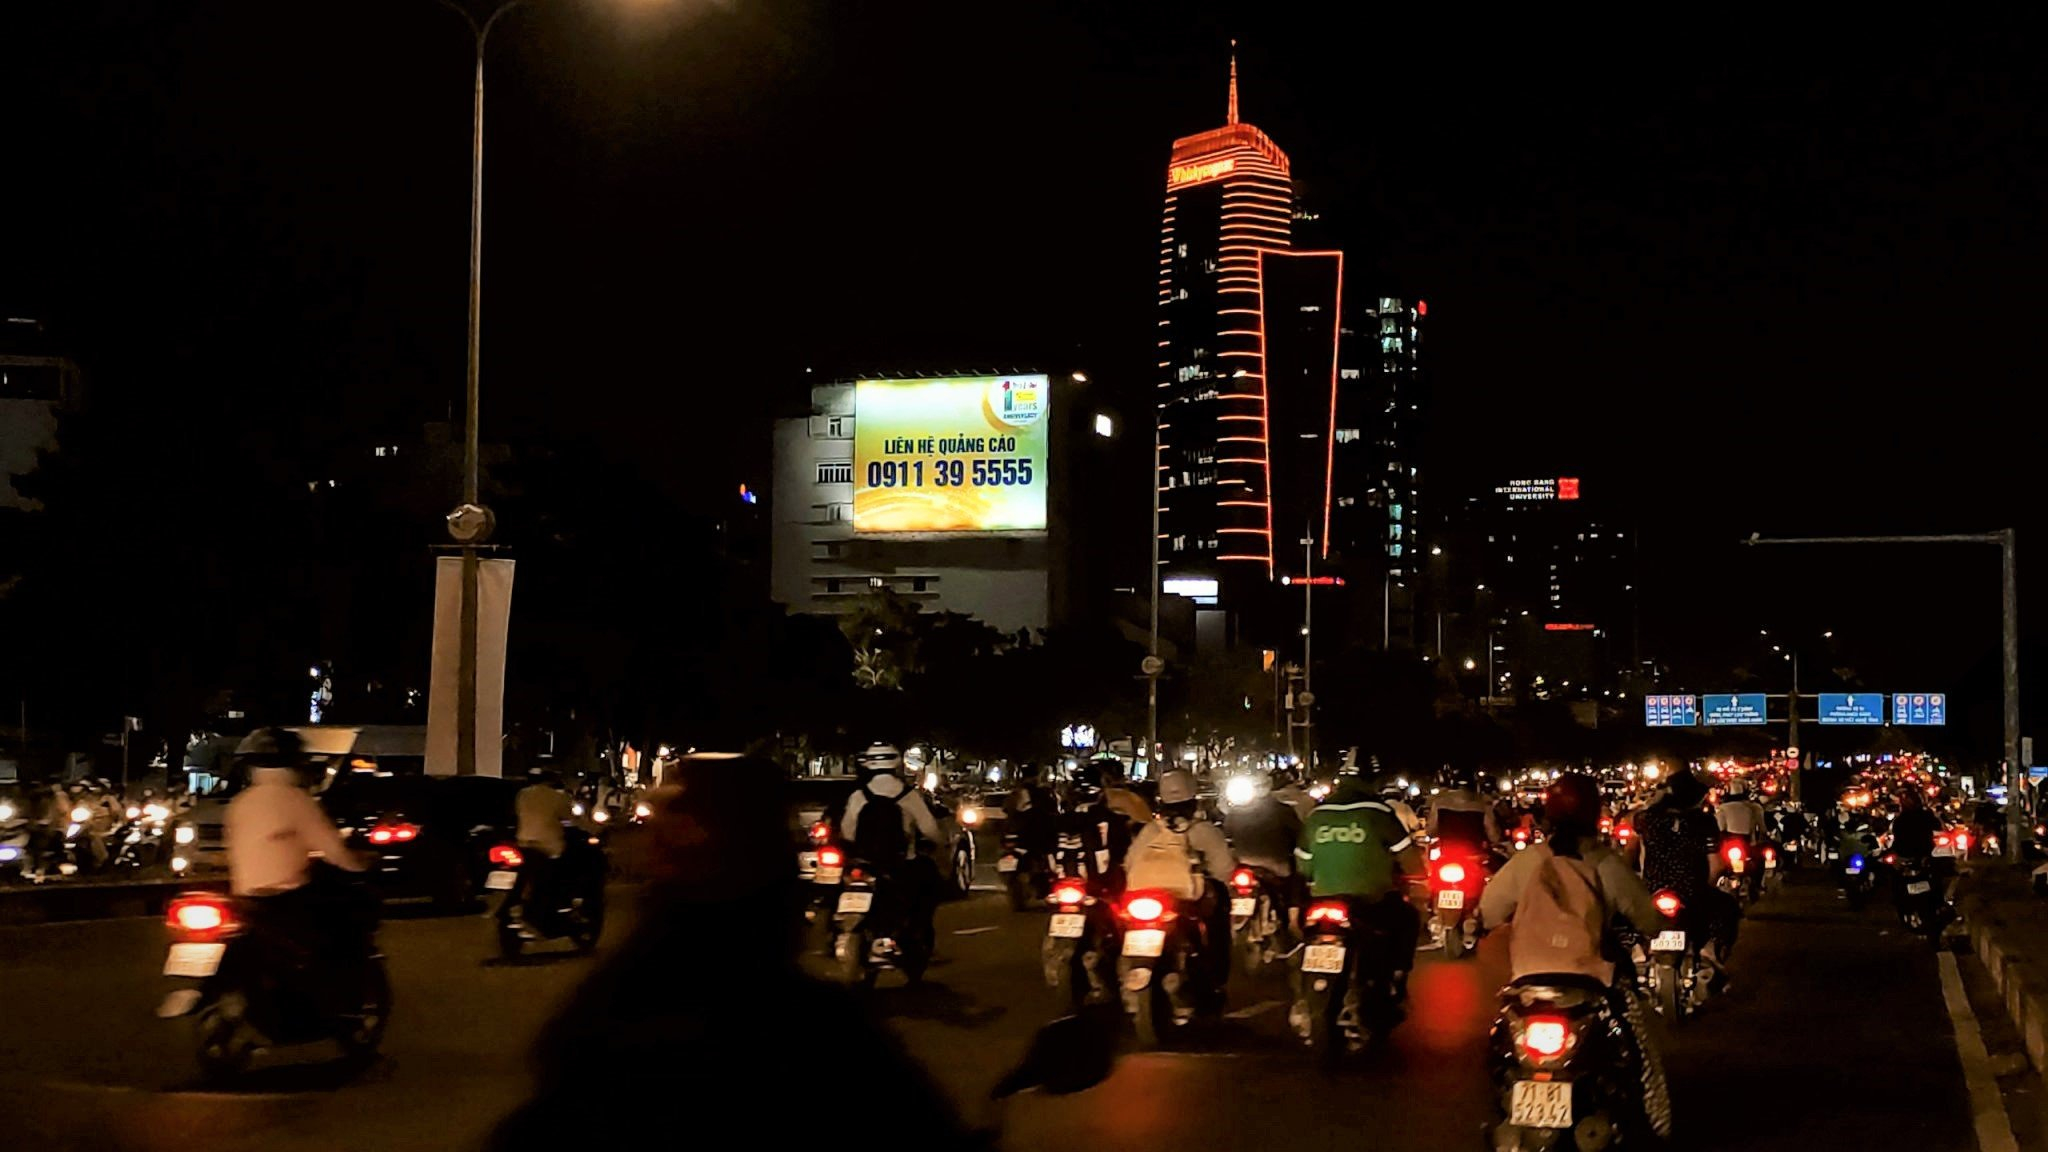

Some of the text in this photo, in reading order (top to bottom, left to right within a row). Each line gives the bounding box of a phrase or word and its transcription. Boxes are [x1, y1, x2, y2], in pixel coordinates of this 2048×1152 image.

[885, 433, 1016, 457] LIÊN HỆ QUẢNG CÁO
[867, 458, 1033, 488] 0911 39 5555
[1315, 822, 1366, 843] Grab
